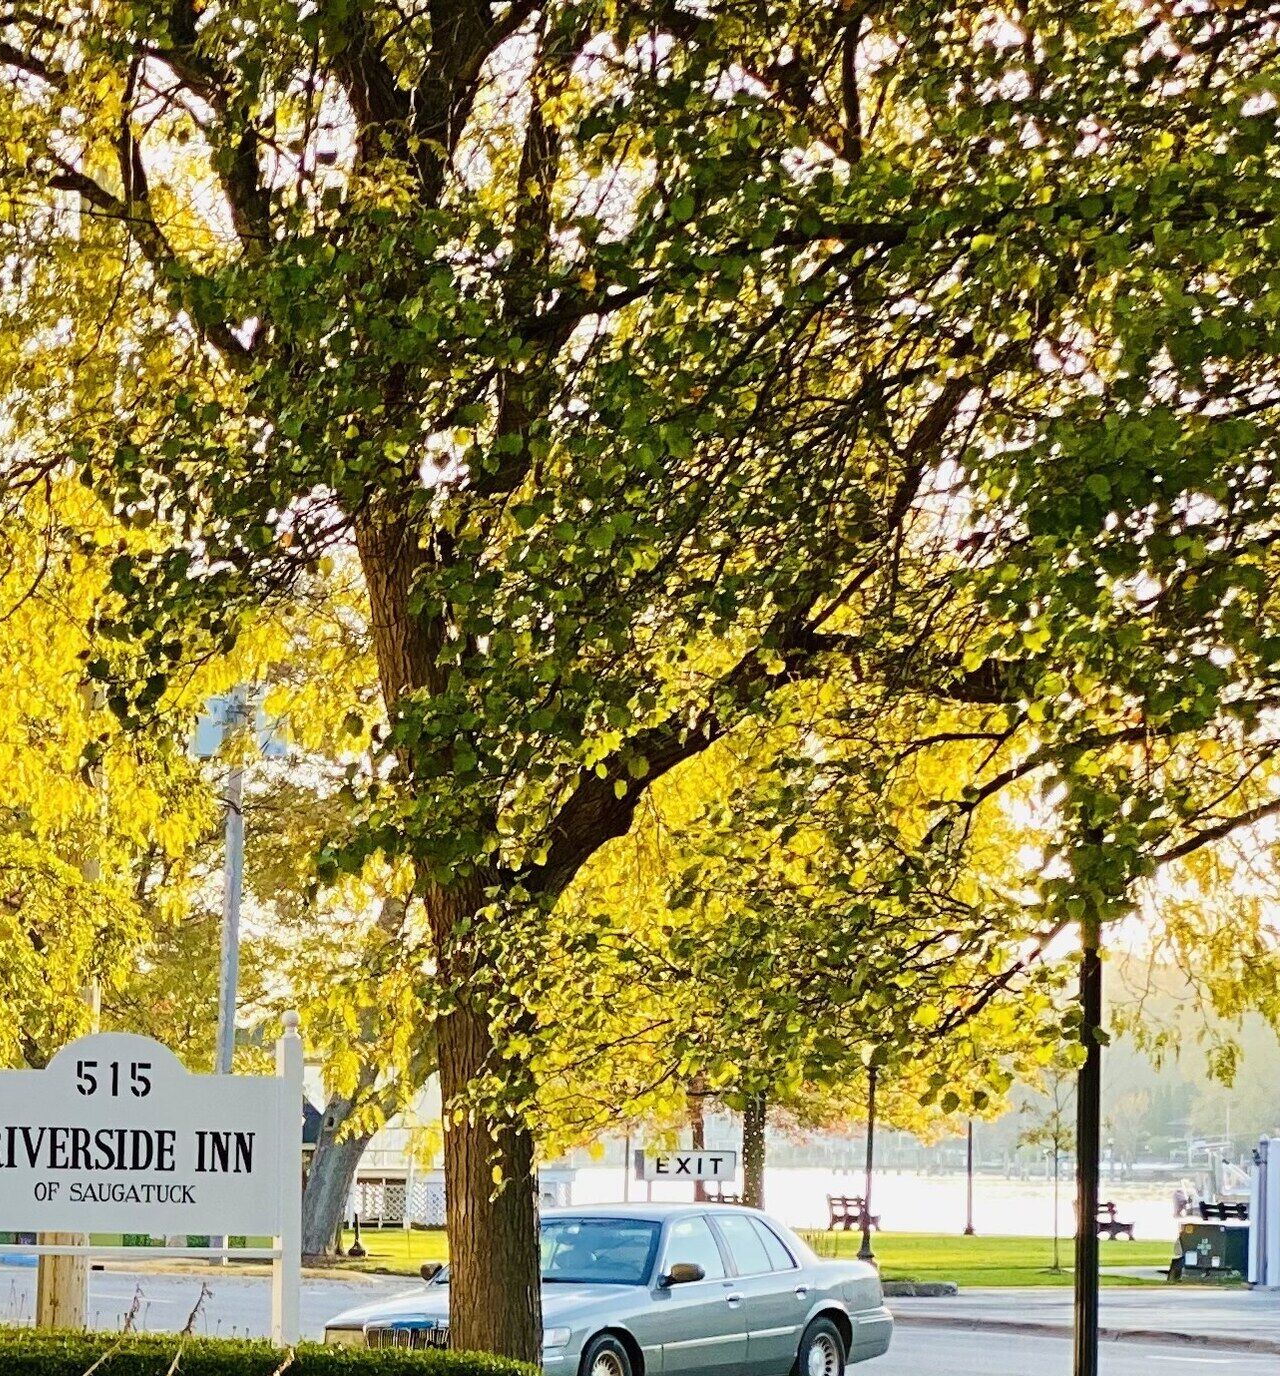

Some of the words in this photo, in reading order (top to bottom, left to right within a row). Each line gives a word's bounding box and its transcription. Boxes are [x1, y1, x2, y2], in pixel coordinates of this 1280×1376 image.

[76, 1060, 152, 1098] 515
[195, 1130, 256, 1174] INN
[656, 1157, 723, 1175] EXIT
[34, 1181, 61, 1202] OF
[70, 1182, 197, 1204] SAUGATUCK
